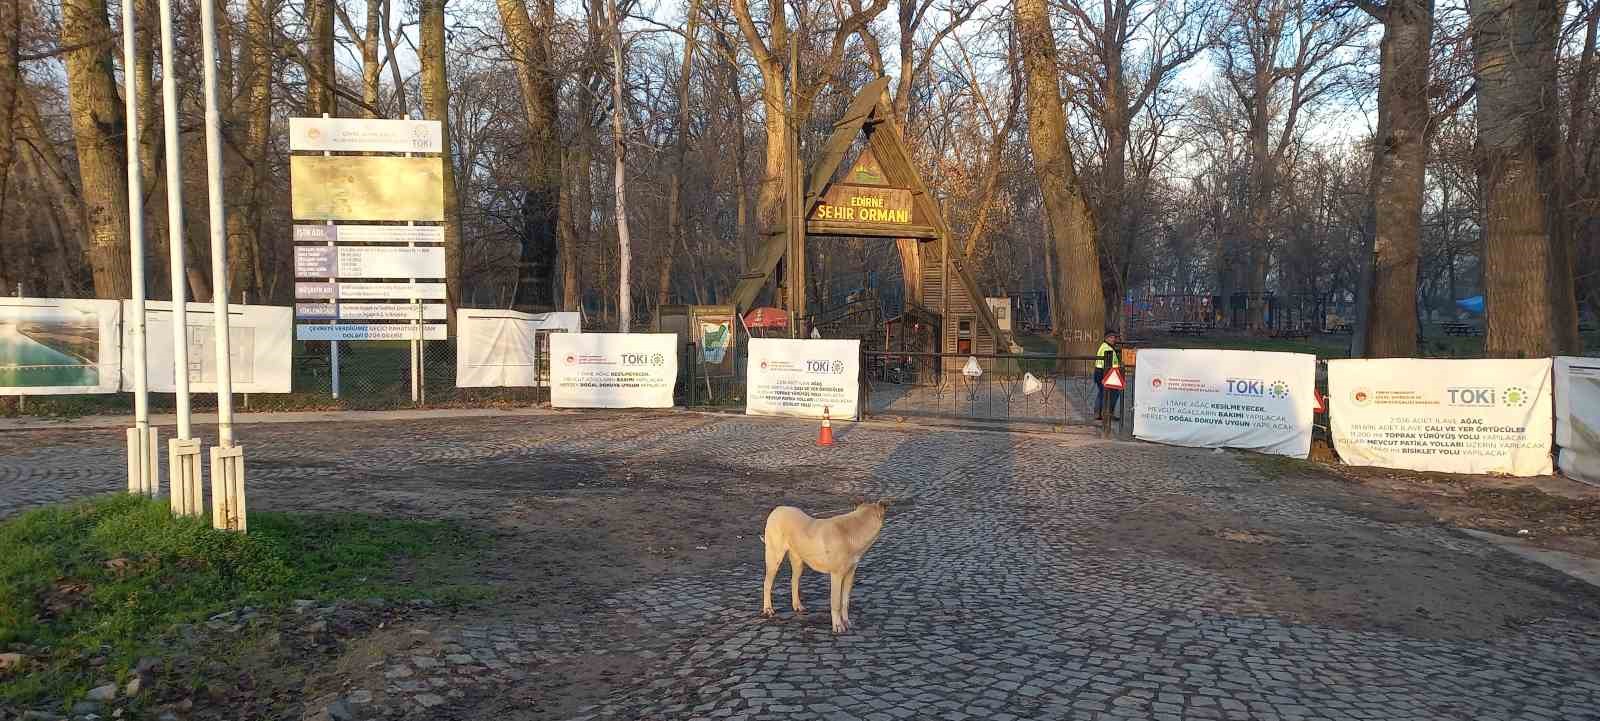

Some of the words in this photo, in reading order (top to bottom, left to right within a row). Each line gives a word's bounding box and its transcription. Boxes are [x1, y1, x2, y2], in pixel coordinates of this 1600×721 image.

[859, 208, 908, 223] ORMANI
[1169, 414, 1193, 423] DOĞAL
[1195, 417, 1223, 425] DOKUYA
[1225, 419, 1250, 428] UYGUN
[1460, 417, 1484, 426] AĞAÇ
[1385, 432, 1416, 440] TOPRAK
[1418, 432, 1457, 442] YÜRÜYÜŞ
[1458, 433, 1481, 441] YOLU
[1367, 439, 1398, 447] MEVCUT
[1399, 439, 1429, 448] PATİKA
[1401, 447, 1437, 455] BİSİKLET
